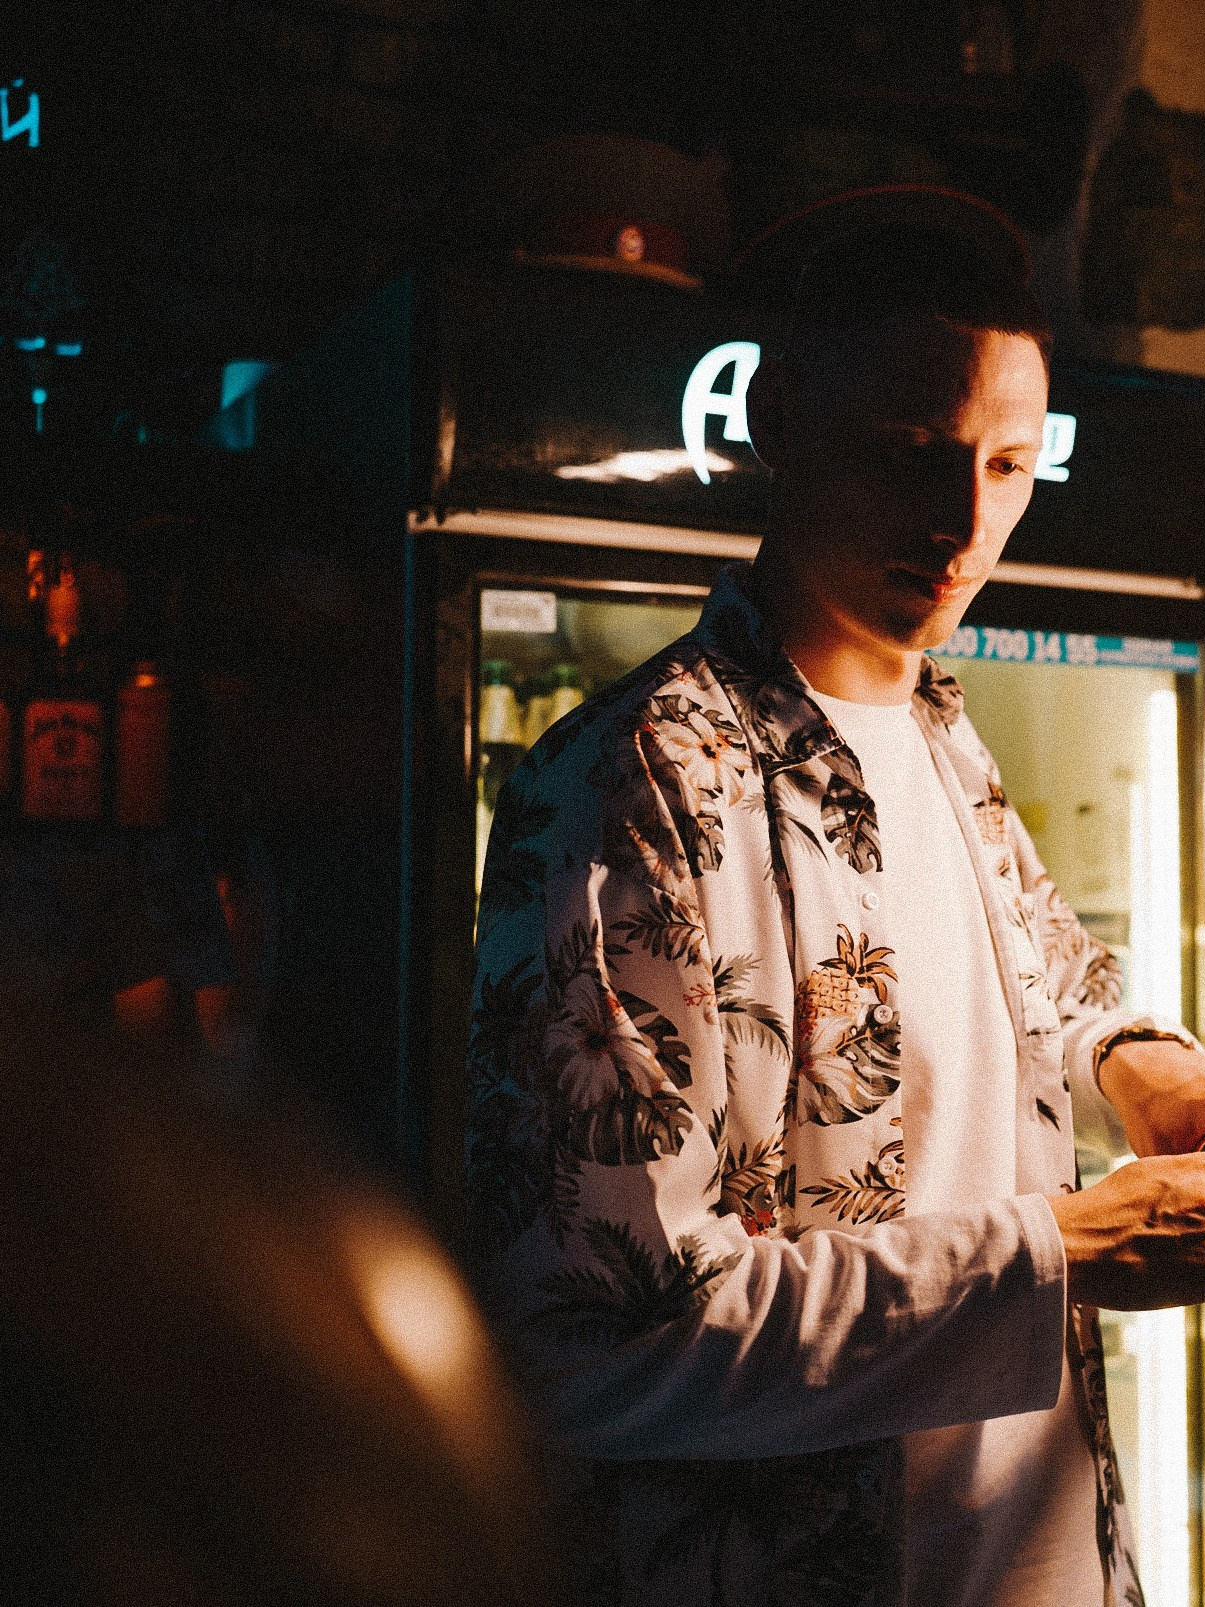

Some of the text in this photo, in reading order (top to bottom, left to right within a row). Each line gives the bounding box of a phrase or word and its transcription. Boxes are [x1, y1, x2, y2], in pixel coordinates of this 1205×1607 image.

[937, 626, 977, 657] 00
[983, 627, 1029, 661] 700
[1034, 630, 1061, 662] 14
